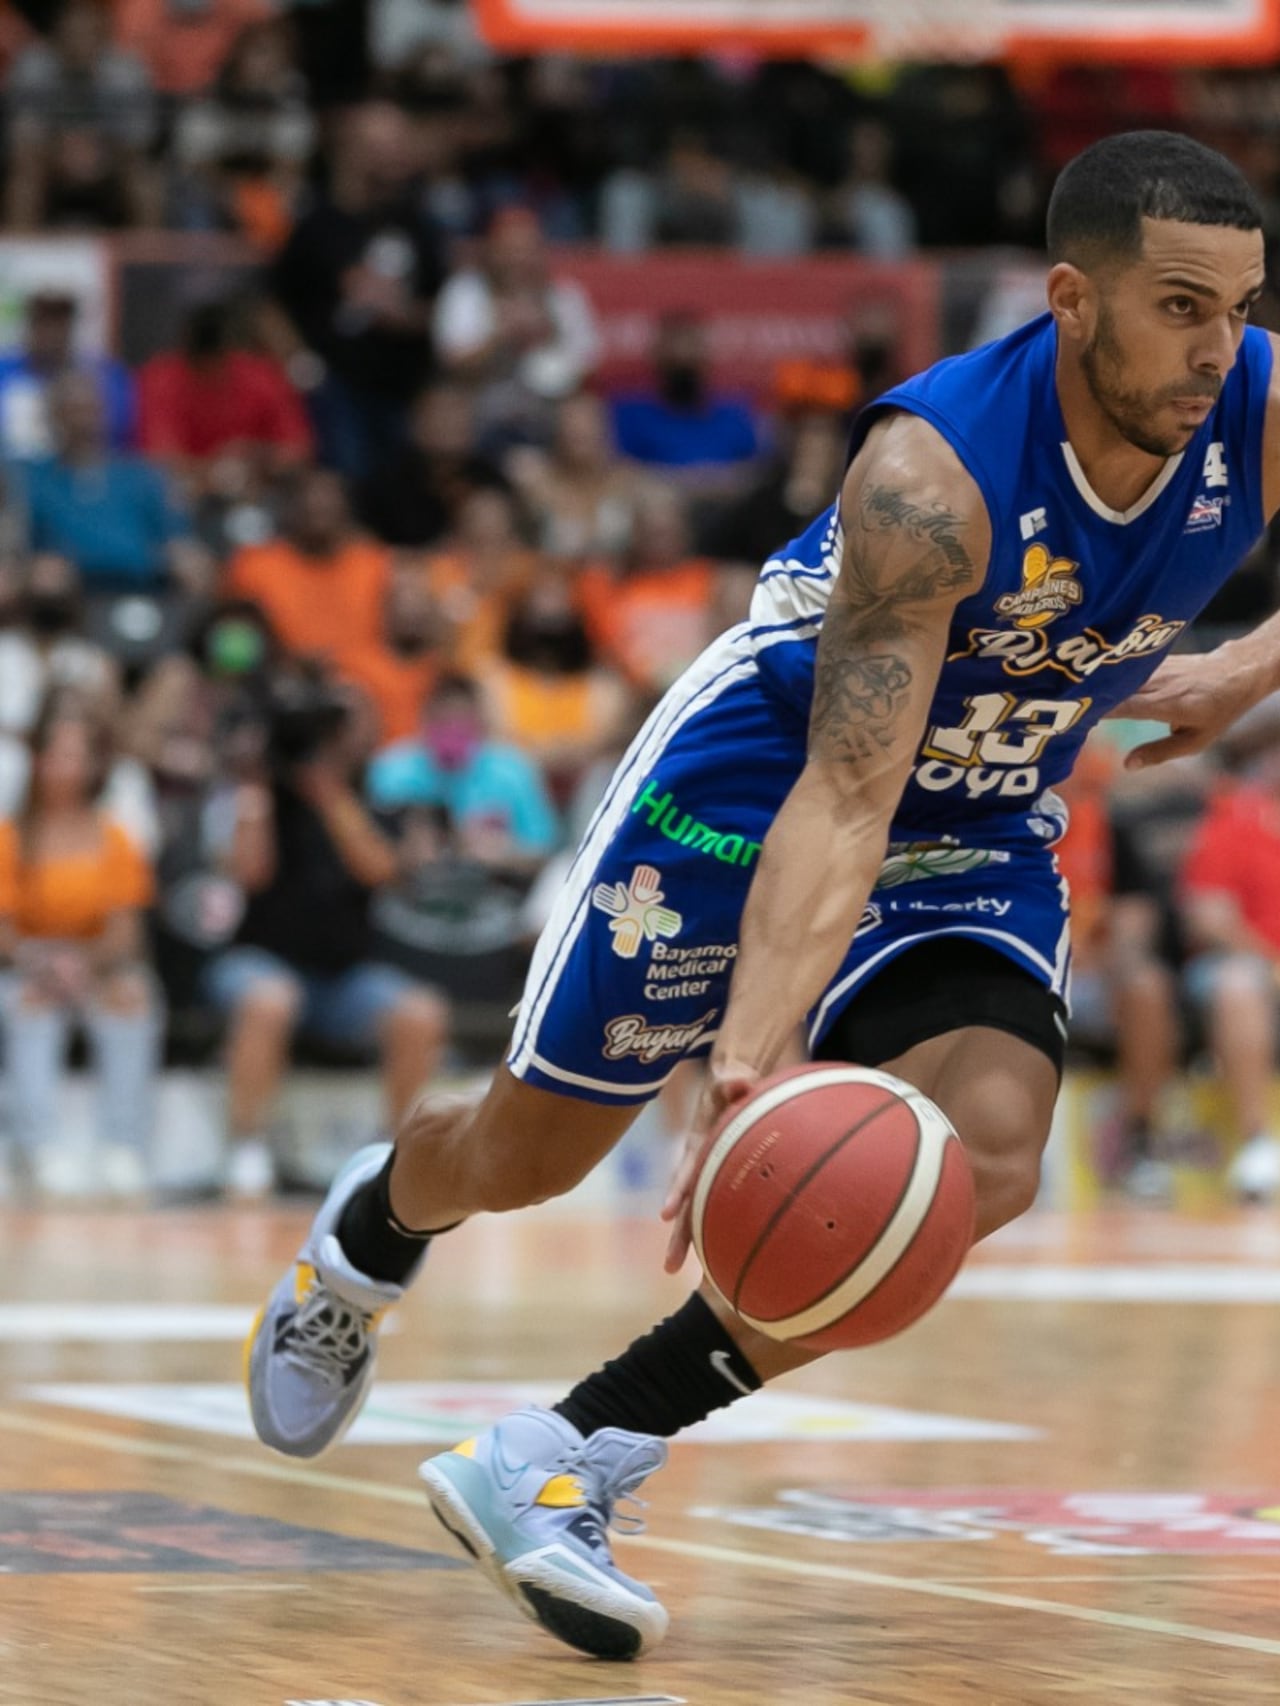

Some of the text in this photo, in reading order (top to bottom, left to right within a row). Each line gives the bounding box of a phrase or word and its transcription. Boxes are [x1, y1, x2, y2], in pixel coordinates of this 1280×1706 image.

[1203, 442, 1229, 487] 4
[921, 692, 1093, 765] 13
[631, 780, 763, 867] Human
[651, 942, 738, 963] Bayamó
[646, 959, 729, 981] Medical
[643, 980, 711, 1000] Center
